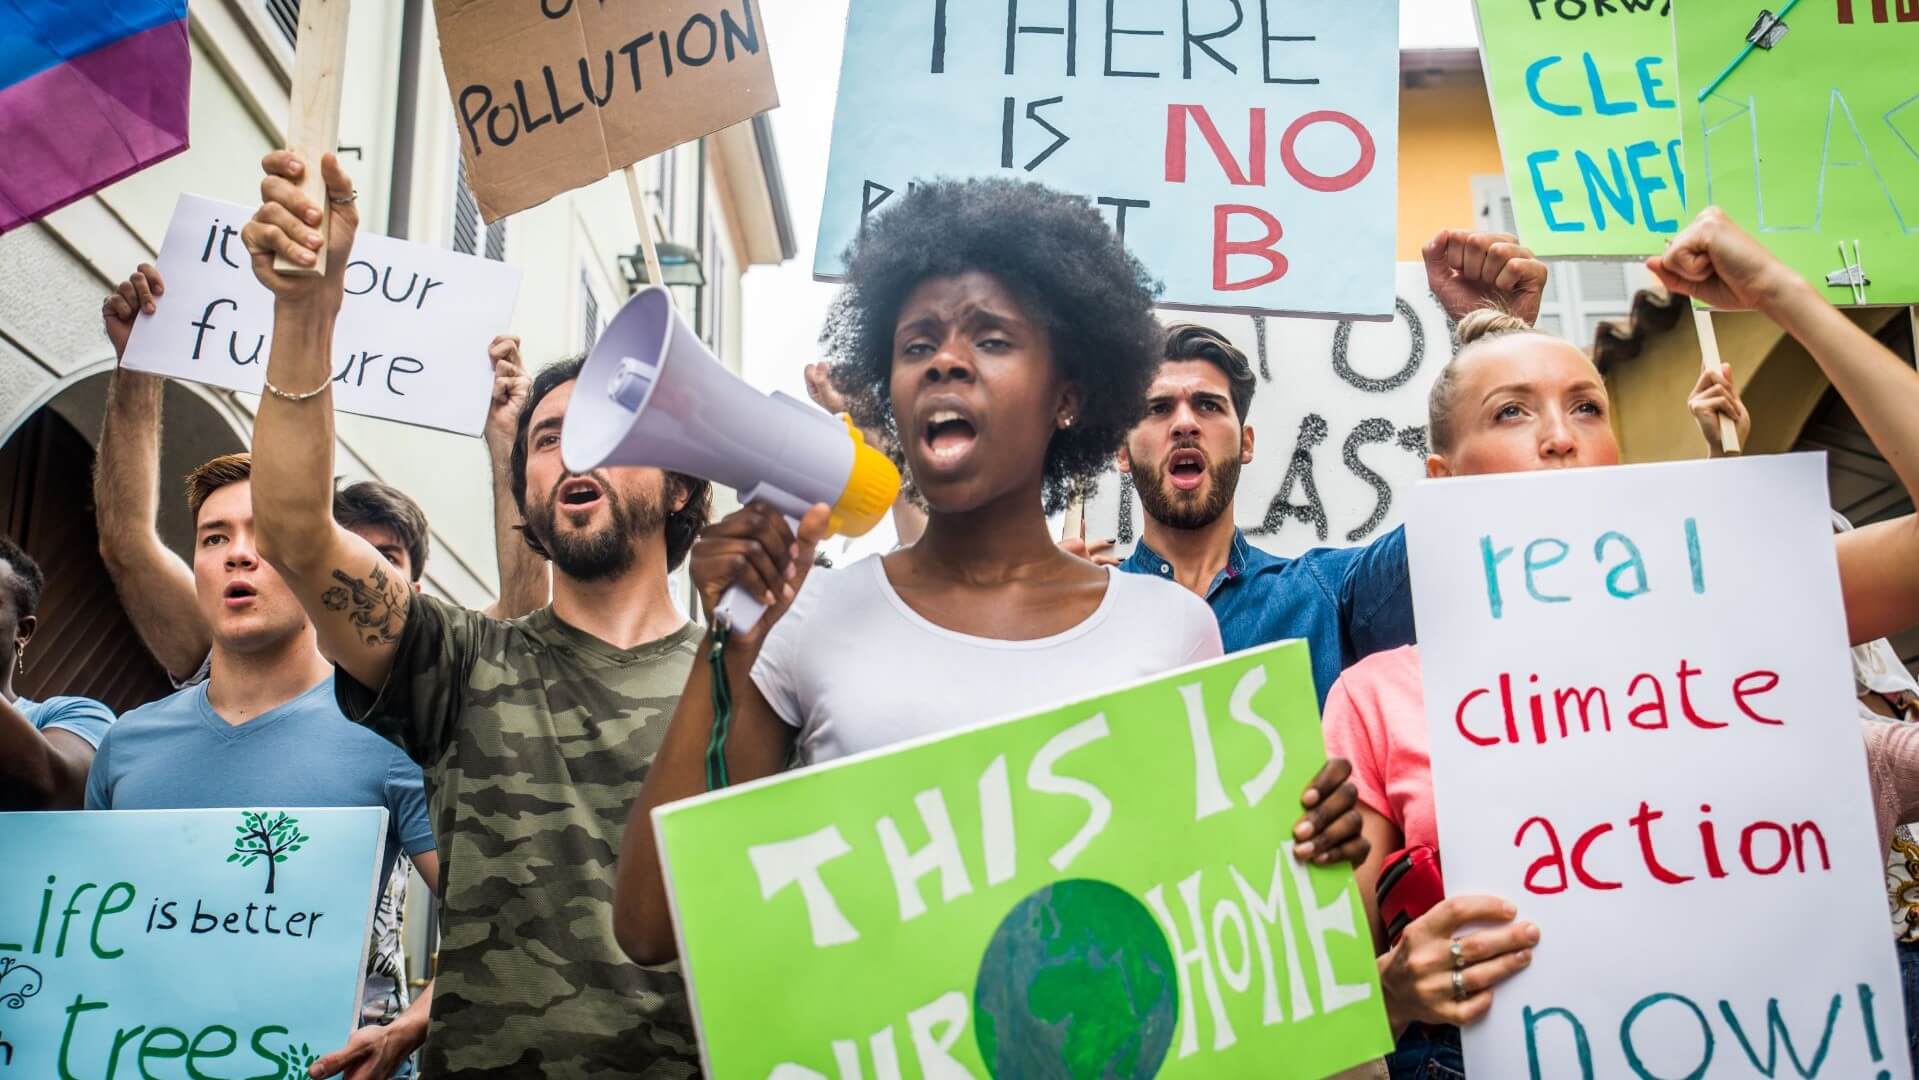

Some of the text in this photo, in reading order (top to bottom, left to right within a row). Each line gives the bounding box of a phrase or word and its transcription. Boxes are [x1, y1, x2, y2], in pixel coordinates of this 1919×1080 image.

[459, 0, 759, 156] POLLUTION
[1001, 96, 1376, 192] IS NO
[1213, 204, 1289, 291] B
[191, 298, 424, 396] fuure
[1479, 517, 1706, 618] real
[1455, 659, 1784, 746] climate
[747, 664, 1285, 948] THIS IS
[1514, 801, 1831, 895] action
[146, 897, 178, 933] is
[190, 900, 325, 938] better
[1143, 840, 1372, 1060] HOME
[58, 993, 289, 1080] trees
[1522, 983, 1892, 1080] now!
